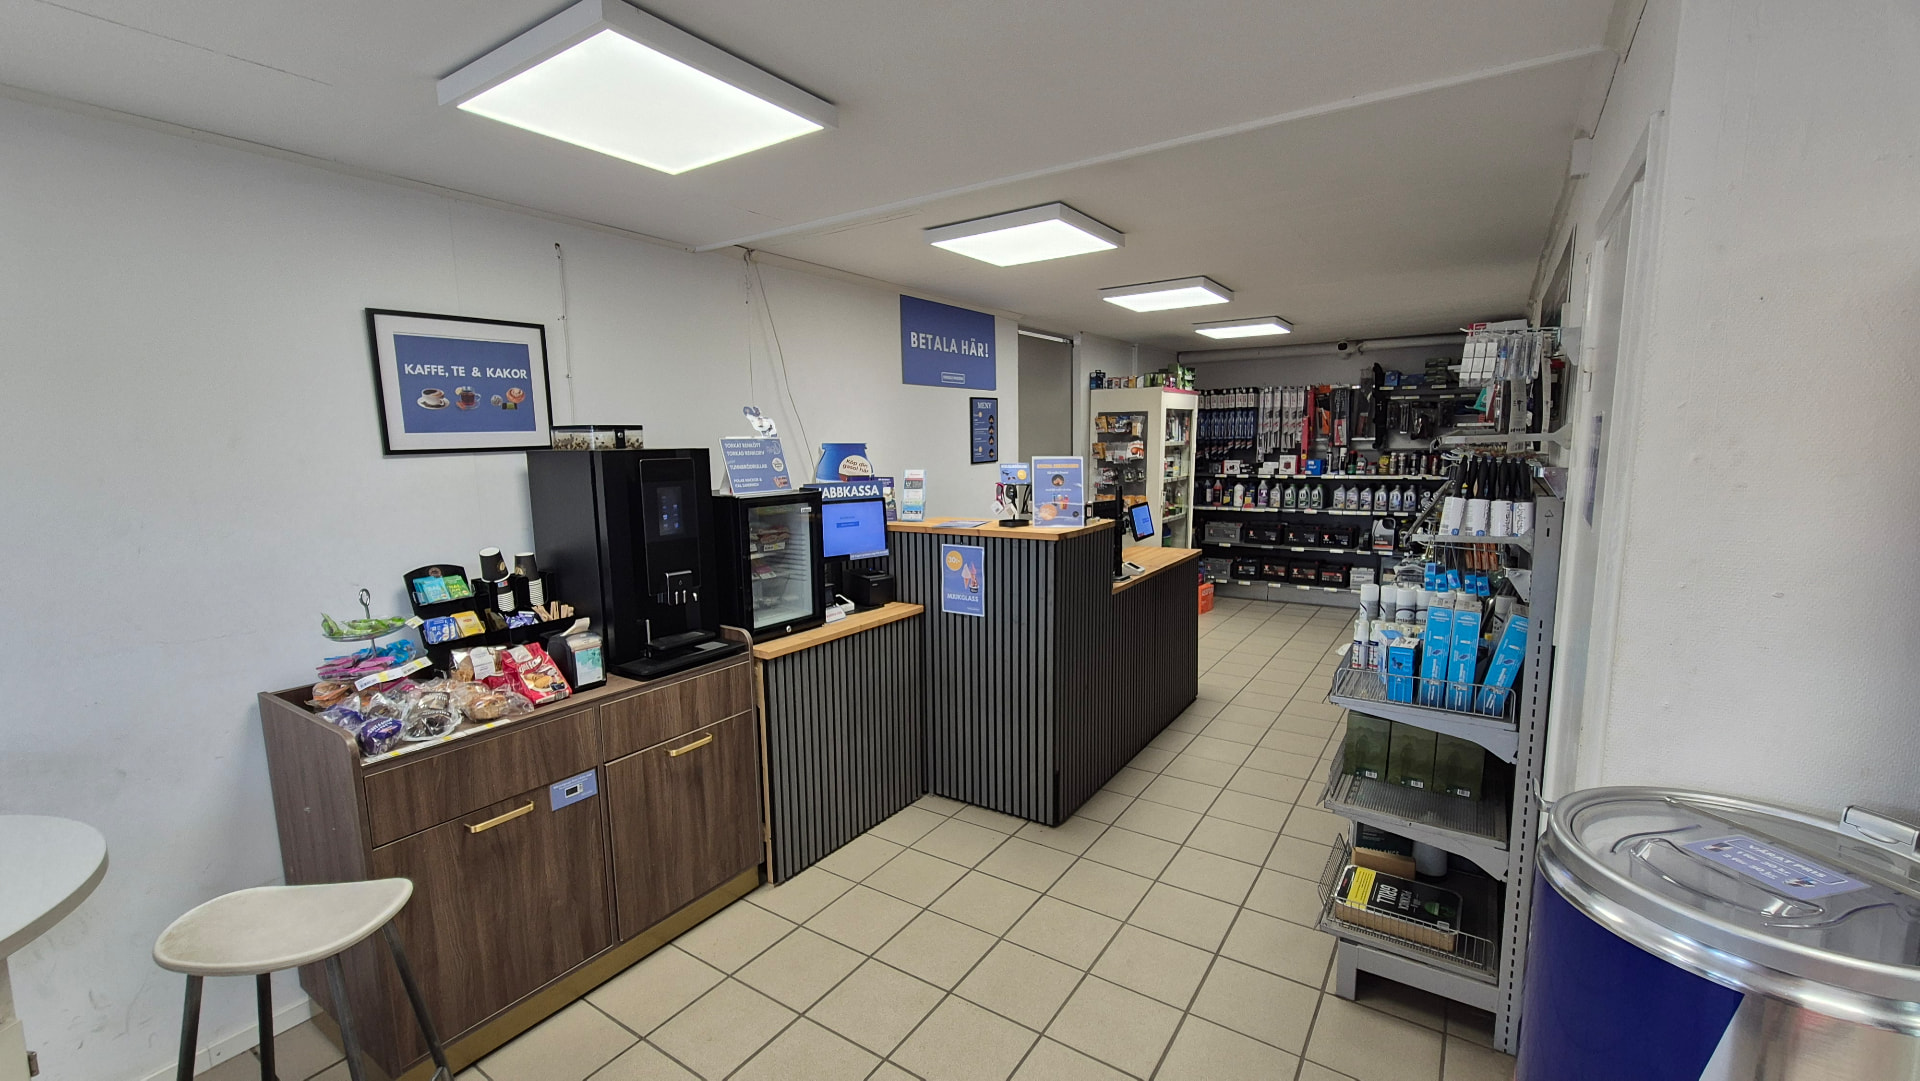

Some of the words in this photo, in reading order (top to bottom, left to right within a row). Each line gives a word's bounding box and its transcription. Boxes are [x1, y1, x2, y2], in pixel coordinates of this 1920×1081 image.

[910, 331, 958, 354] BETALA
[961, 337, 989, 358] HÄR!
[404, 363, 449, 379] KAFFE,
[451, 365, 466, 377] TE
[471, 366, 482, 378] &
[486, 367, 528, 380] KAKOR
[846, 459, 857, 467] Köp
[819, 484, 880, 499] ABBKASSA
[1748, 844, 1796, 864] VÅRAT
[1793, 863, 1827, 878] PRIS
[1376, 883, 1399, 905] GRILL
